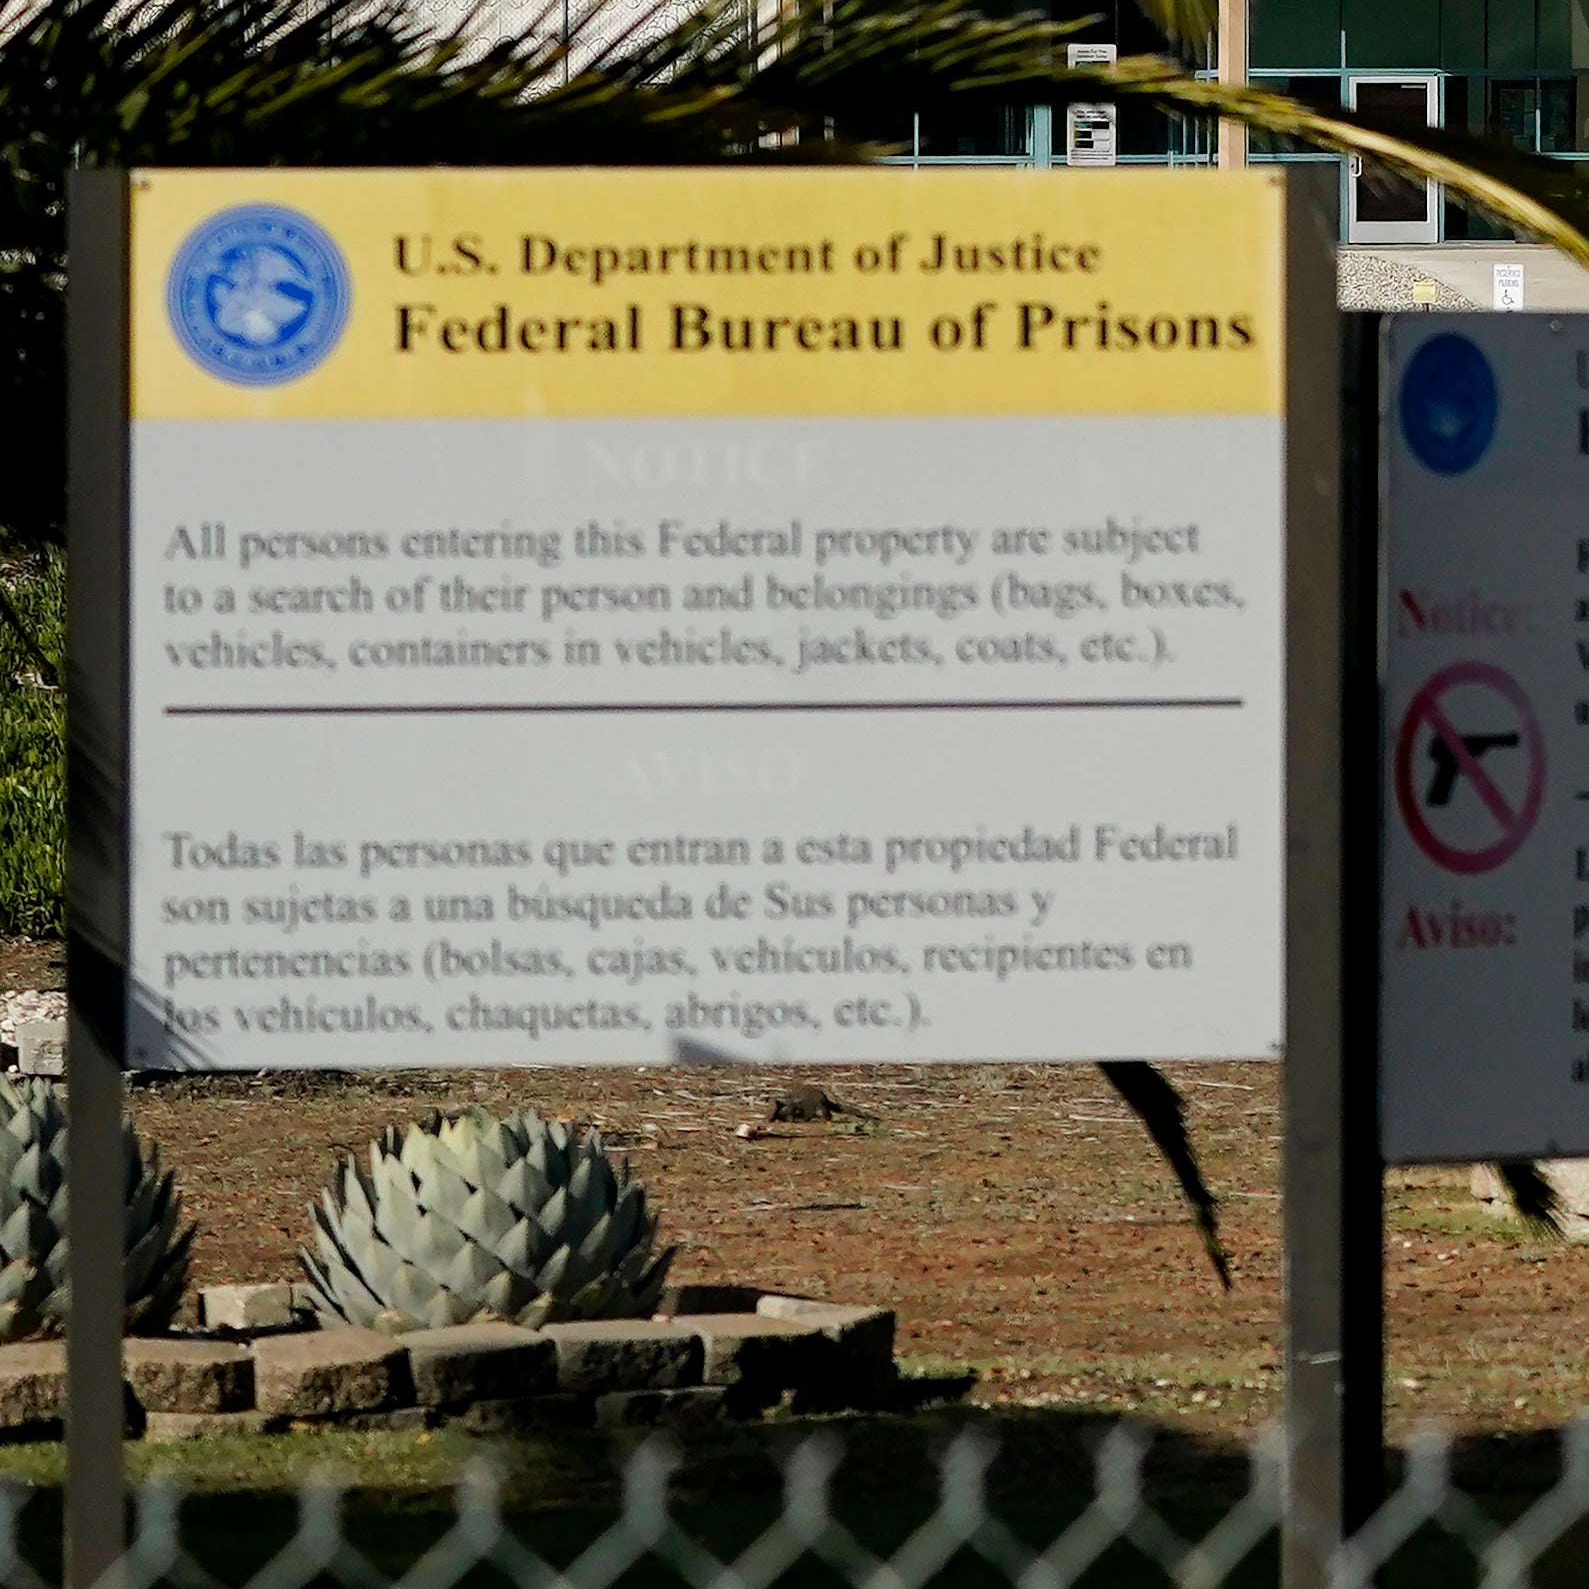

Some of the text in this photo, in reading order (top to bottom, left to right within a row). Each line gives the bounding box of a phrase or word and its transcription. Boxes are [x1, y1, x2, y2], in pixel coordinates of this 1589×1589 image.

[395, 233, 1100, 283] U.S. Department of Justice
[397, 302, 1254, 353] Federal Bureau of Prisons
[584, 437, 833, 491] NOTICE
[165, 517, 1199, 568] All persons entering this Federal property are subject
[164, 570, 1245, 620] to a search of their person and belongings (bags, boxes,
[164, 630, 337, 671] vehicles,
[348, 630, 552, 667] containers
[564, 630, 601, 667] in
[614, 627, 785, 667] vehicles,
[796, 627, 944, 673] jackets,
[955, 632, 1068, 666] coats,
[163, 824, 1238, 876] Todas las personas que entran a esta propiedad Federal
[161, 897, 230, 925] son
[243, 885, 378, 933] sujetas
[389, 896, 411, 922] a
[424, 895, 495, 922] una
[704, 882, 752, 920] de
[847, 891, 1019, 929] personas
[1031, 890, 1053, 927] y
[1395, 903, 1517, 950] Aviso:
[164, 939, 412, 988] pertenencias
[423, 938, 575, 981] (bolsas,
[587, 937, 698, 985] cajas,
[923, 934, 1135, 982] recipientes
[1146, 943, 1193, 970] en
[161, 994, 221, 1032] los
[446, 993, 652, 1041] chaquetas,
[665, 991, 822, 1040] abrigos,
